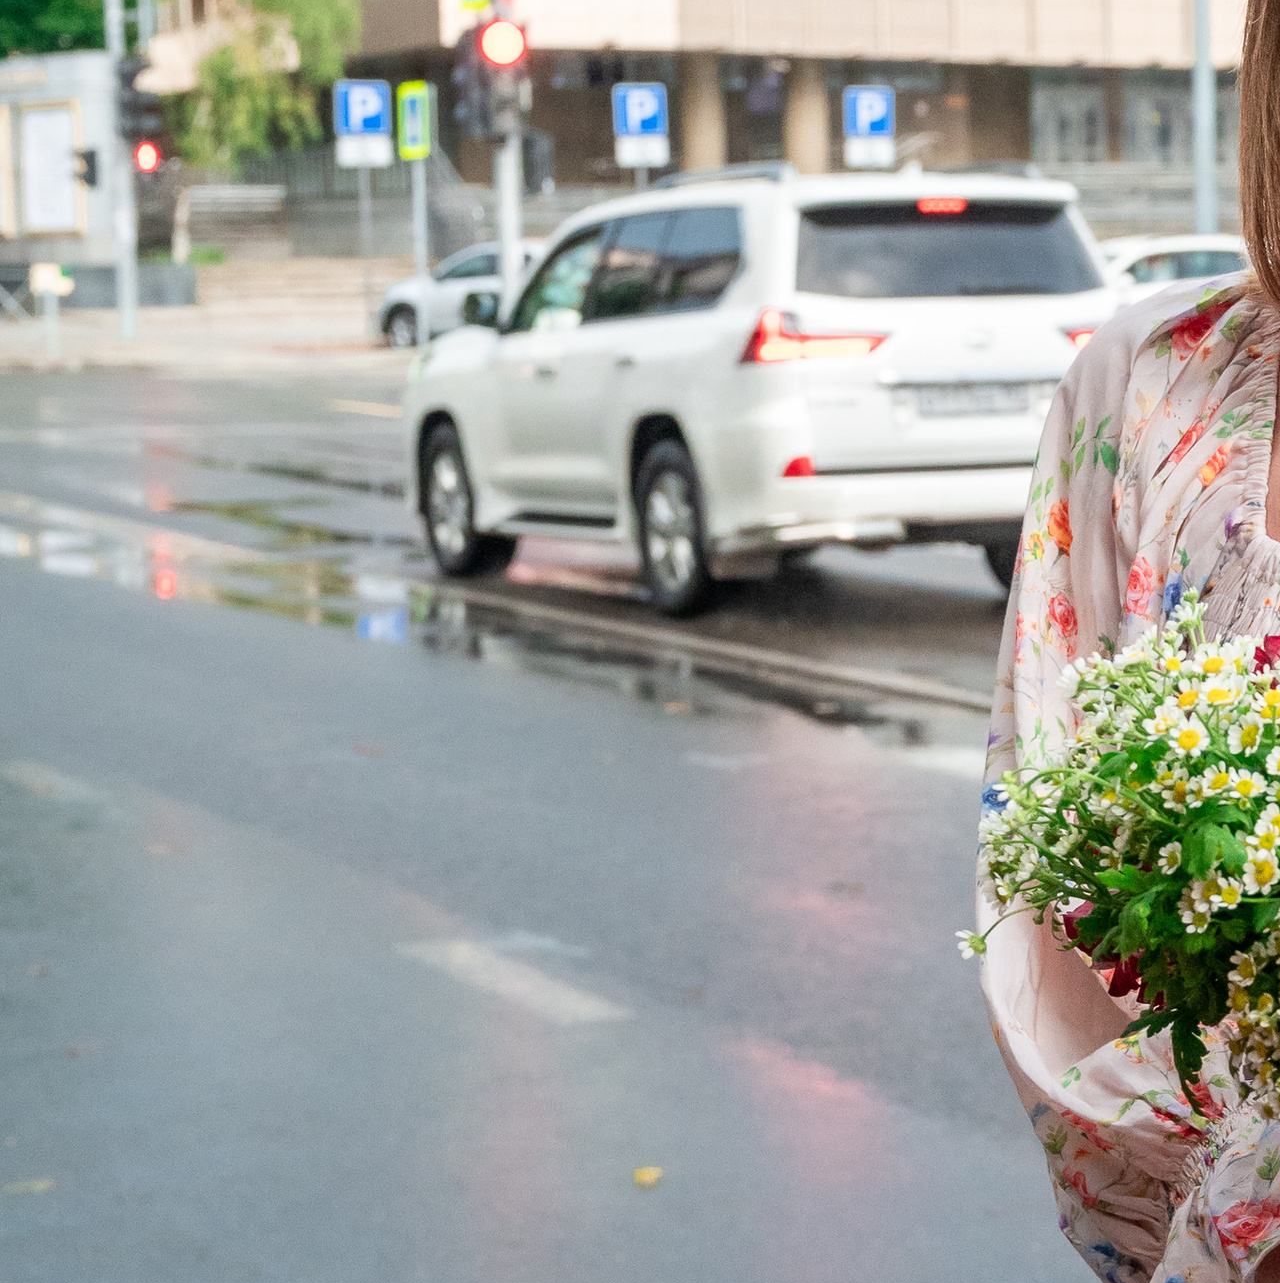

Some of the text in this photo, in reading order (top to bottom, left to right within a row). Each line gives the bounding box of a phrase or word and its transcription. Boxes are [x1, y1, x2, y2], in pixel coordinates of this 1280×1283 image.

[348, 86, 382, 133] P
[626, 89, 659, 134] P
[856, 91, 888, 135] P
